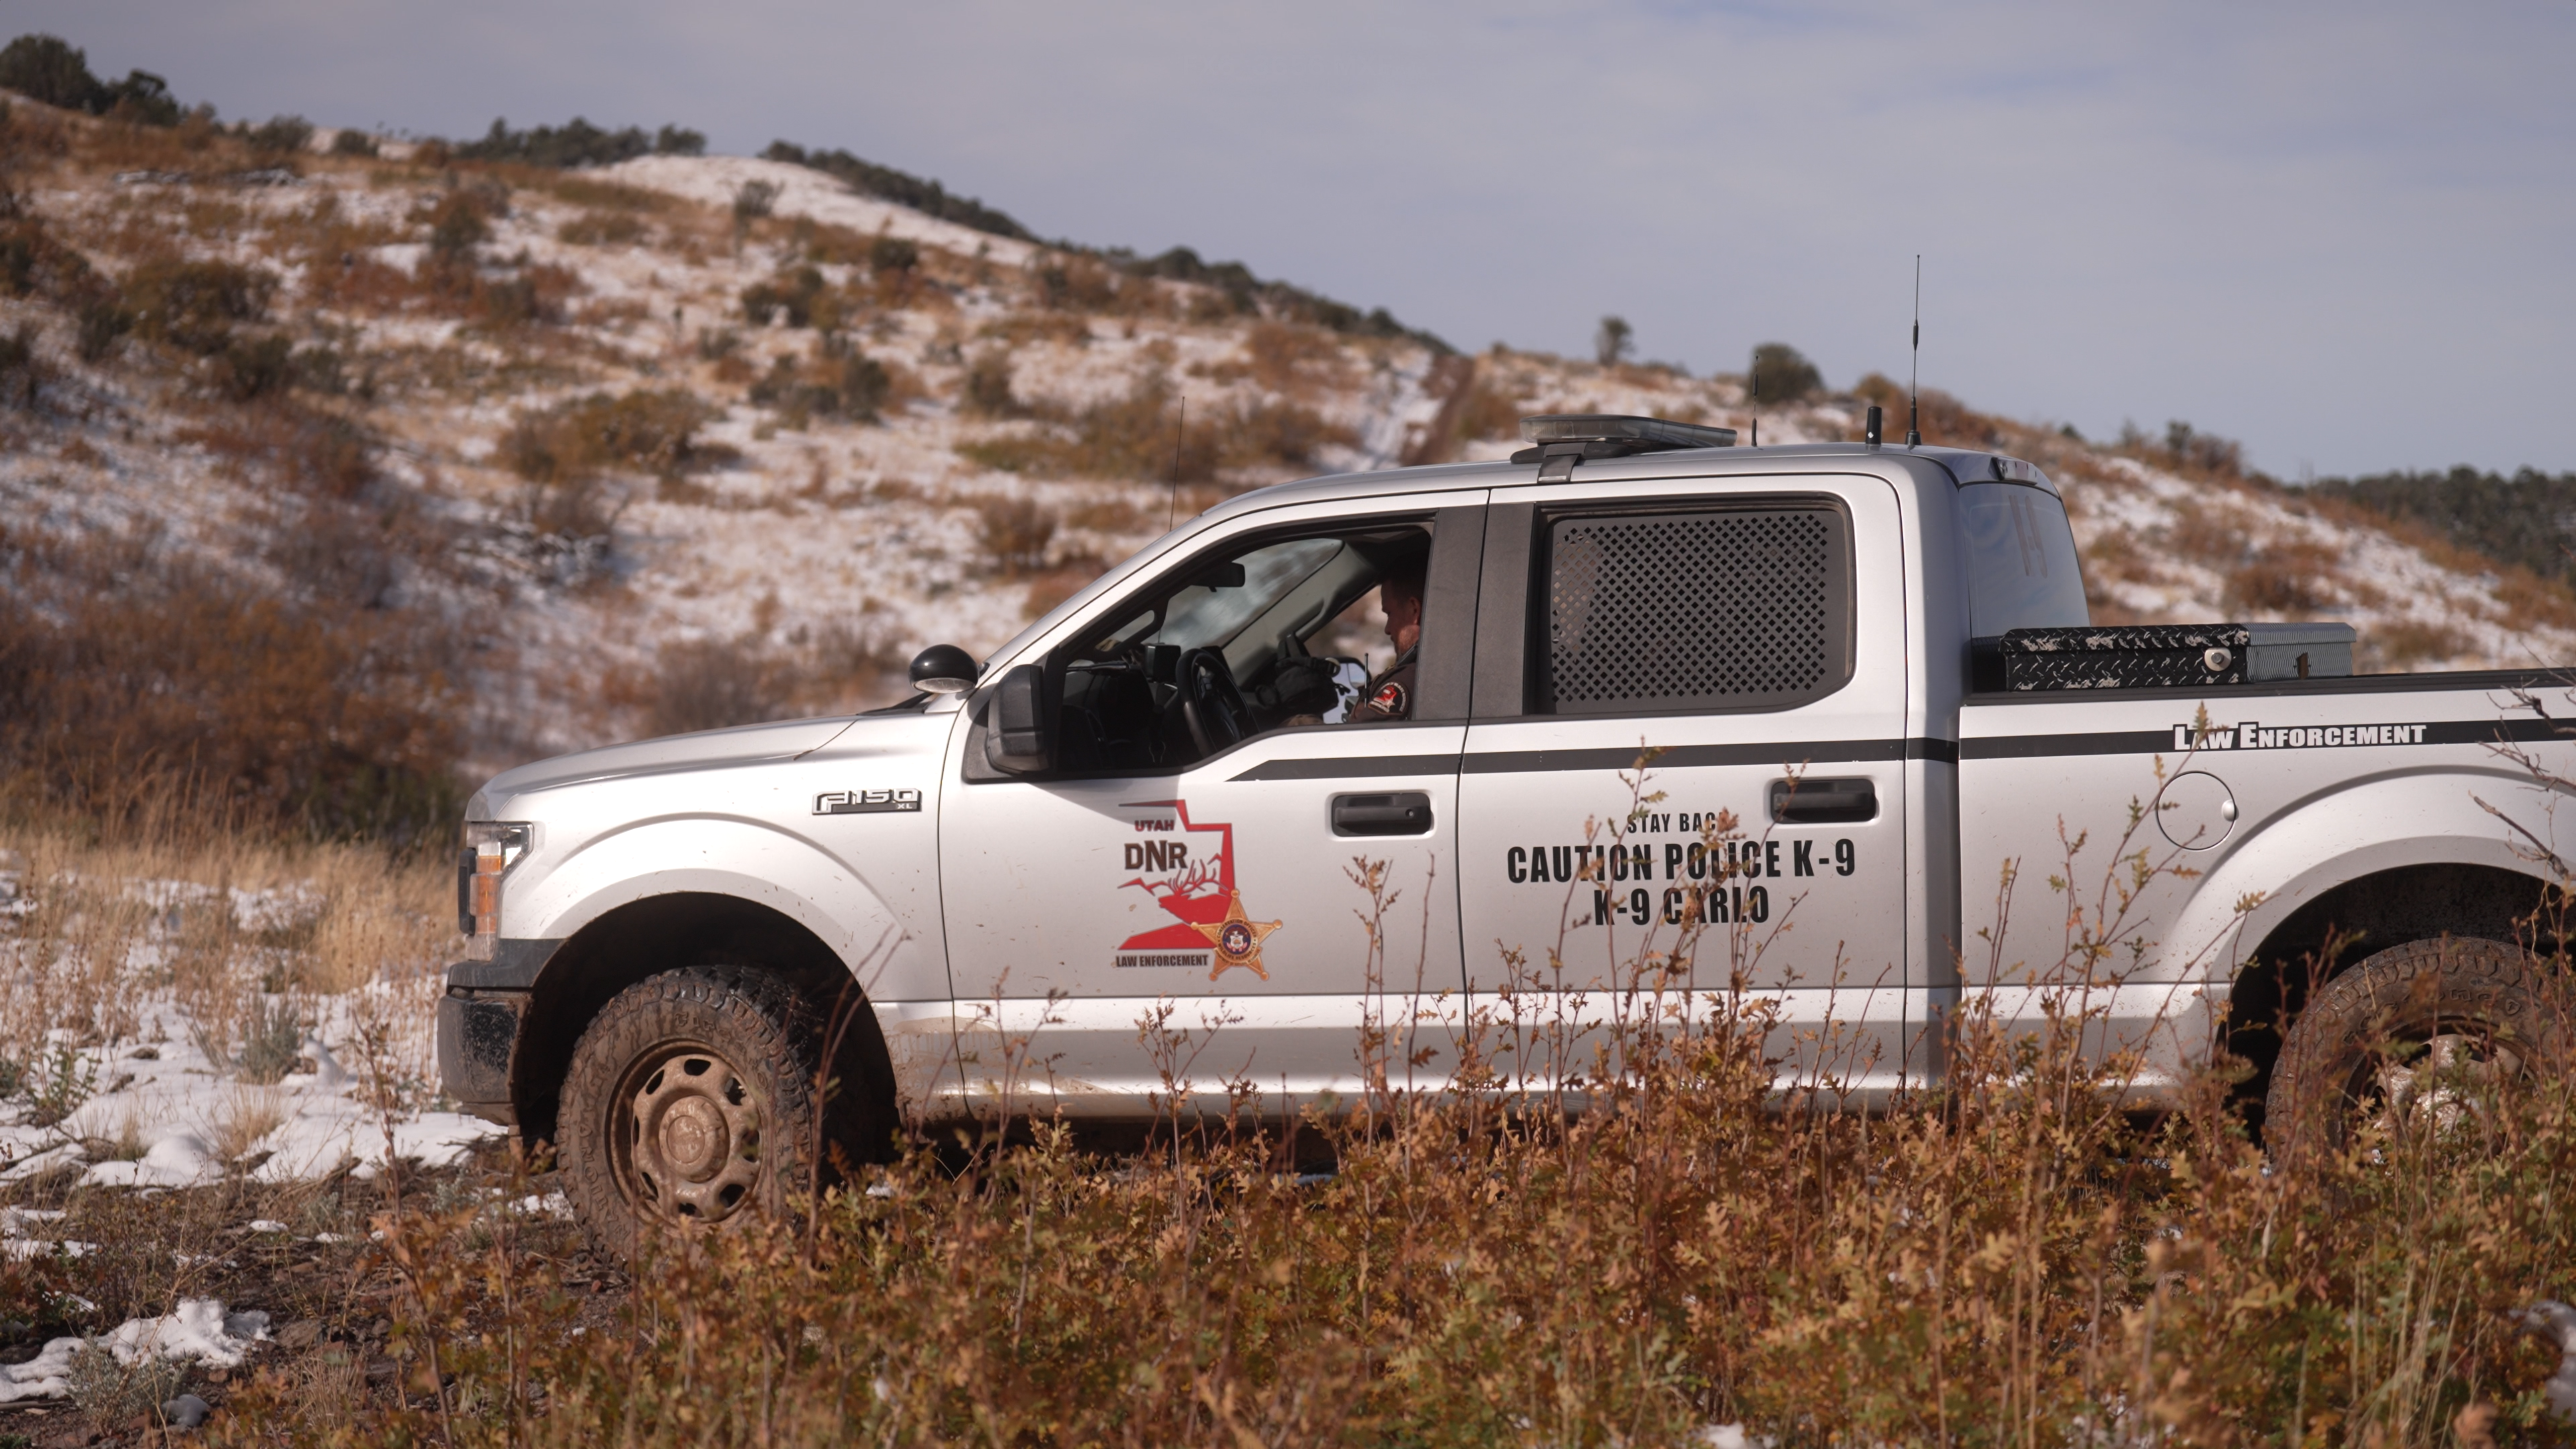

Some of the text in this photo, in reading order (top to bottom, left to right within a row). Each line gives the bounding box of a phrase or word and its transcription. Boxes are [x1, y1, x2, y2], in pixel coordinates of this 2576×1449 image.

[1134, 820, 1174, 832] UTAH
[1627, 812, 1731, 834] STAY BAC
[1124, 840, 1188, 872] DNR
[1507, 839, 1856, 883] CAUTION POLICE K-9
[1594, 886, 1769, 925] K-9 CARLO
[1116, 955, 1137, 967] LAW
[1139, 954, 1209, 967] ENFORCEMENT
